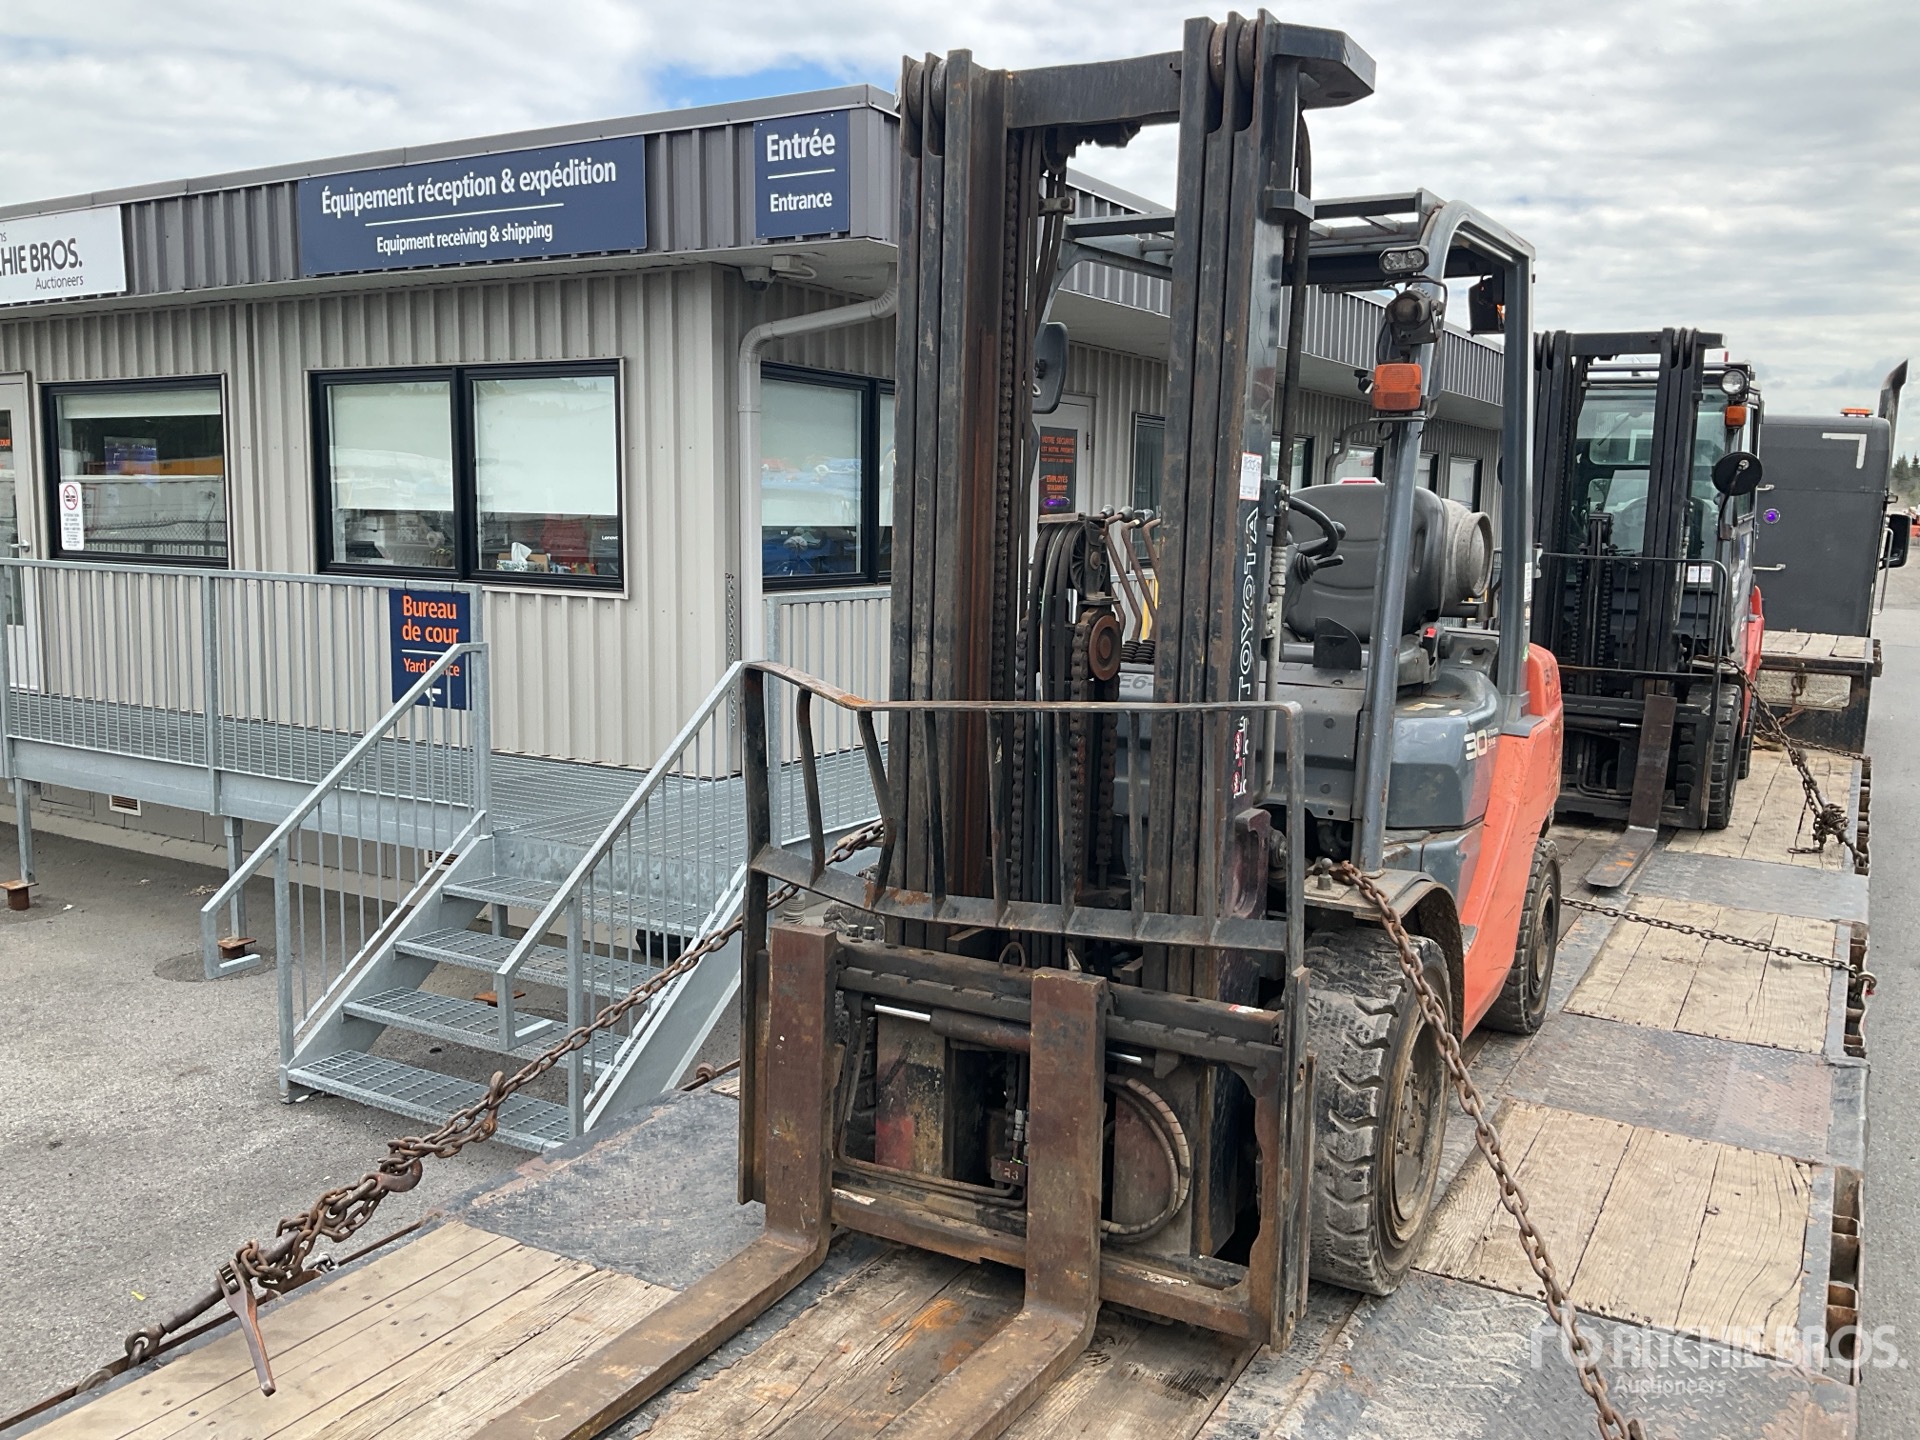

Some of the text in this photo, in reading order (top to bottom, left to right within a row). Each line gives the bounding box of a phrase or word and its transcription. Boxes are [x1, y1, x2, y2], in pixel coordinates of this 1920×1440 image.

[766, 128, 836, 162] Entrée
[321, 157, 617, 219] Équipement réception & expédition
[770, 191, 833, 213] Entrance
[376, 220, 553, 256] Equipment receiving & shipping
[29, 237, 83, 273] BROS.
[35, 275, 84, 291] Auctioneers
[402, 595, 457, 619] Bureau
[1238, 506, 1260, 702] TOYOTA
[402, 618, 459, 644] de cour
[403, 657, 426, 673] Yard
[1464, 729, 1487, 760] 30
